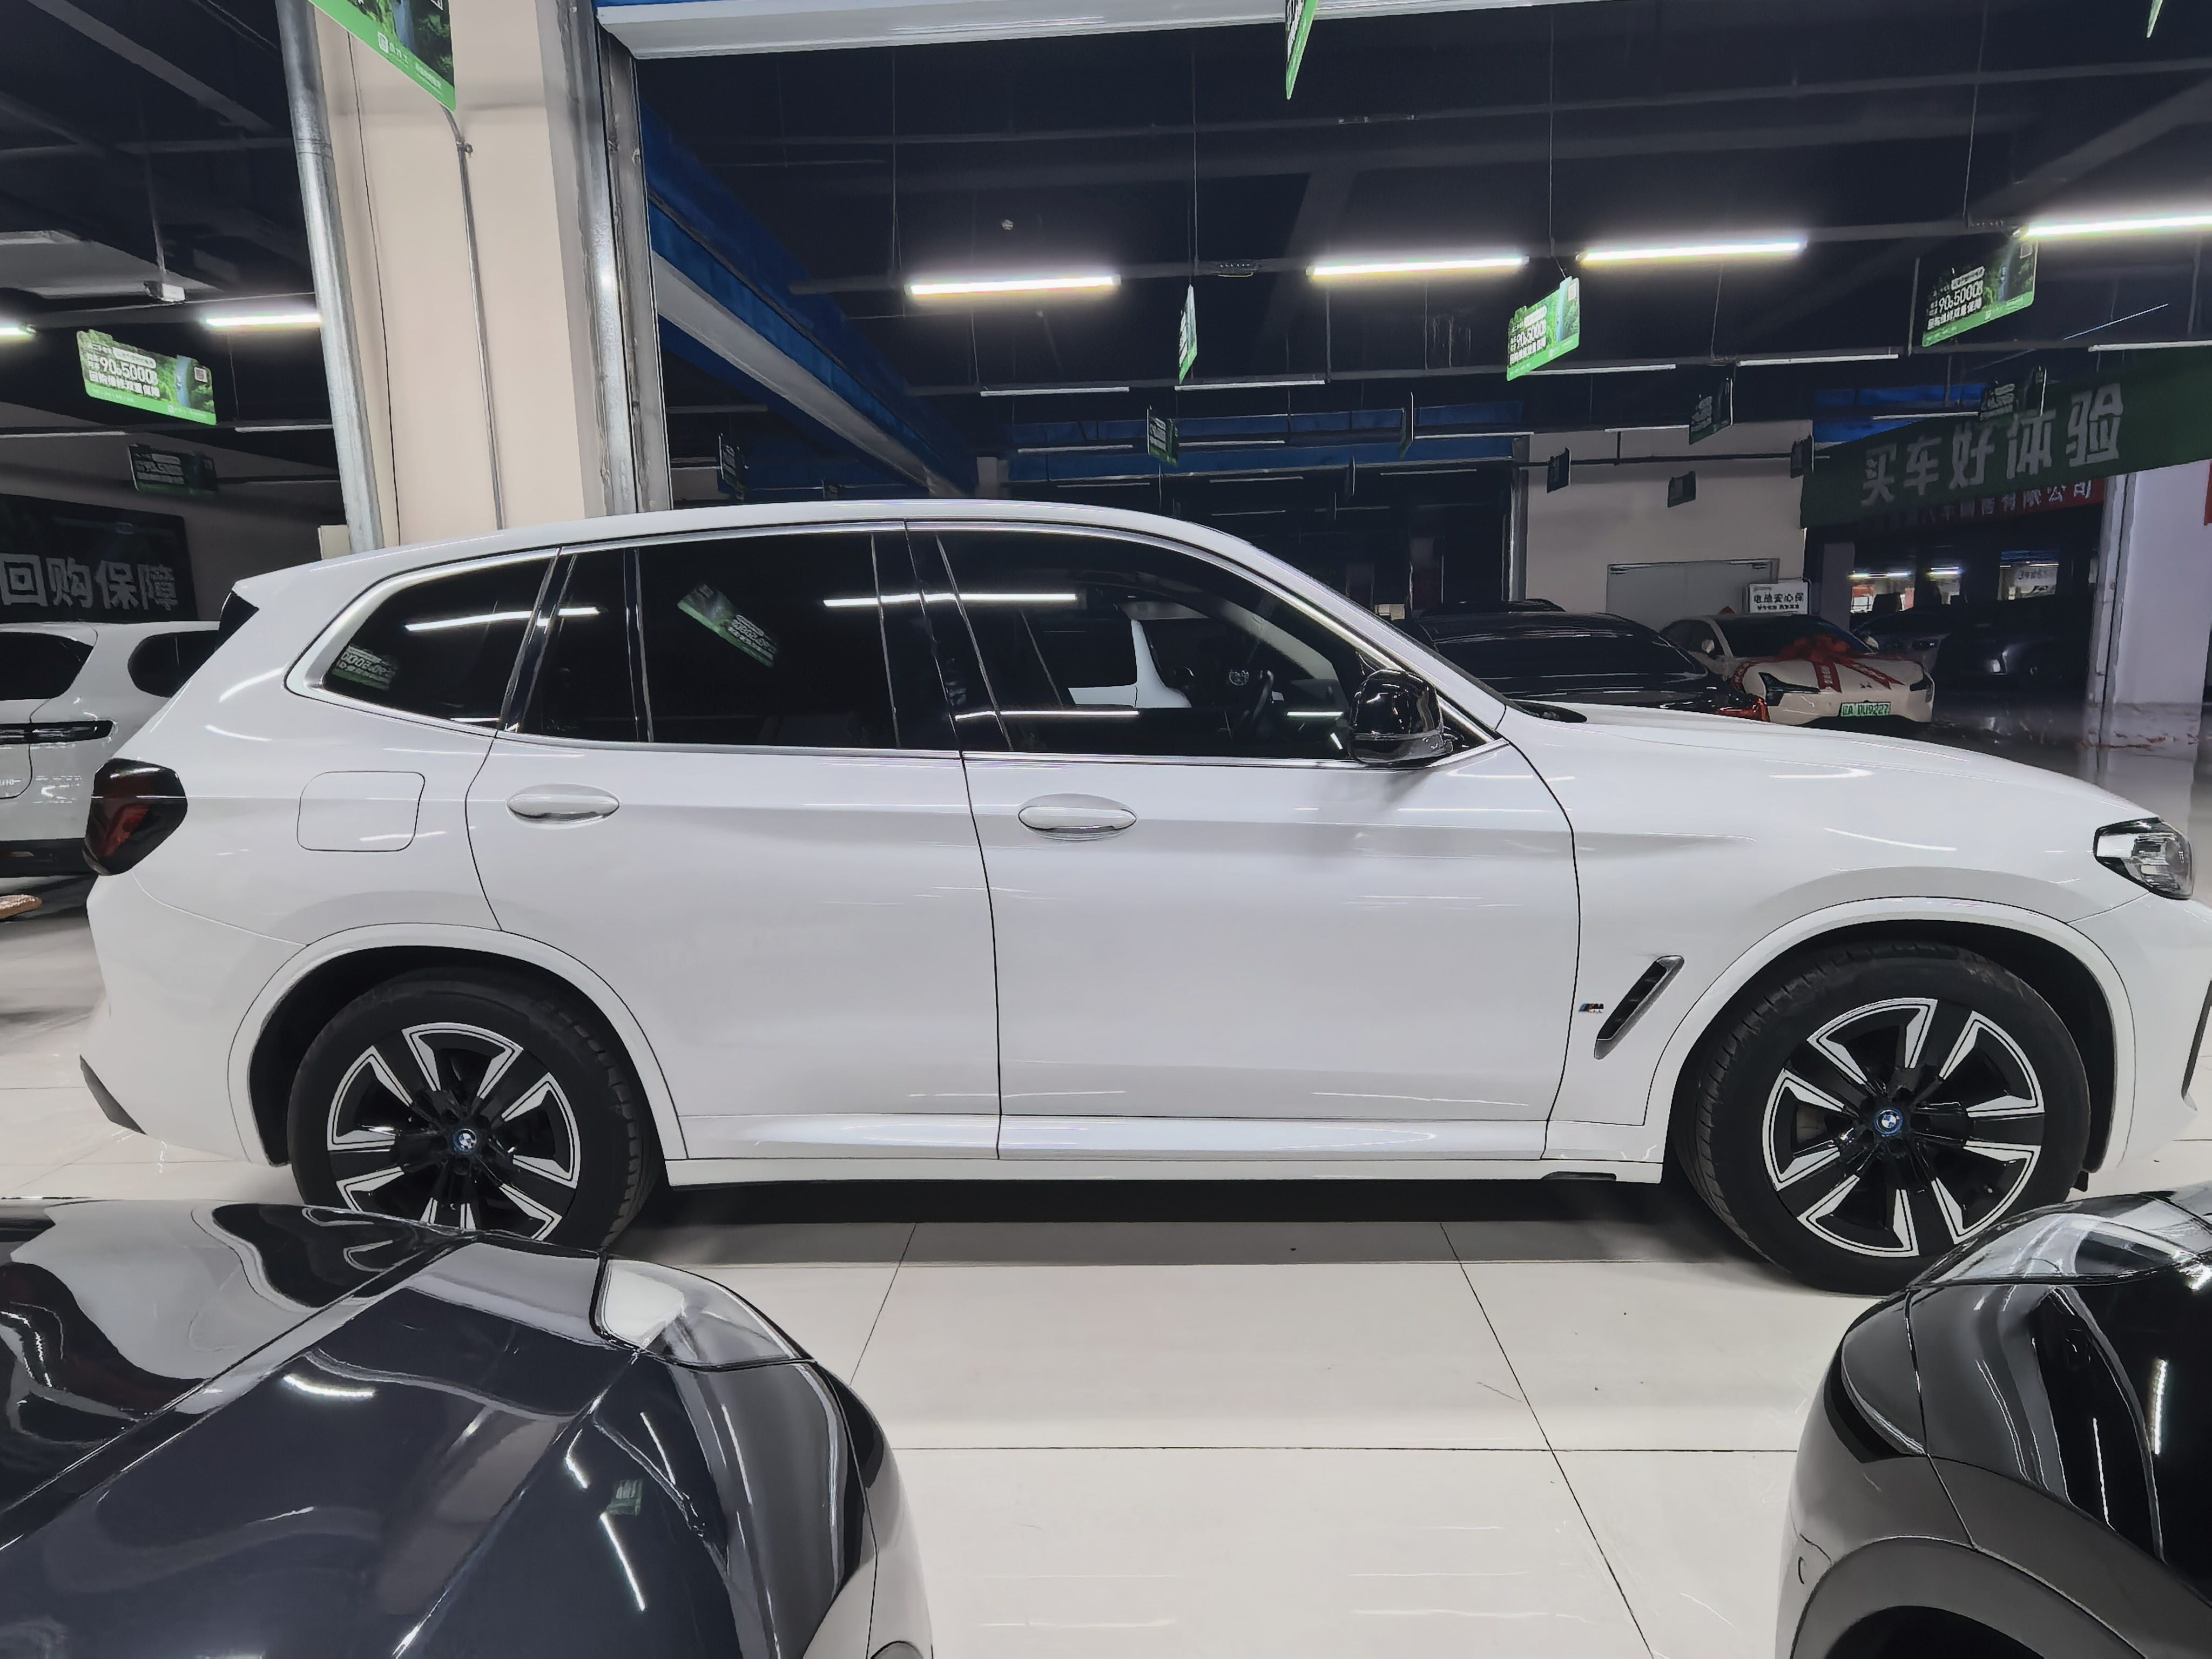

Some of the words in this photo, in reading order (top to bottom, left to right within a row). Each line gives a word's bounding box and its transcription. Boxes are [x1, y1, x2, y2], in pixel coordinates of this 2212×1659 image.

[1861, 382, 2123, 507] 买车好体验
[0, 553, 178, 611] 回购保障
